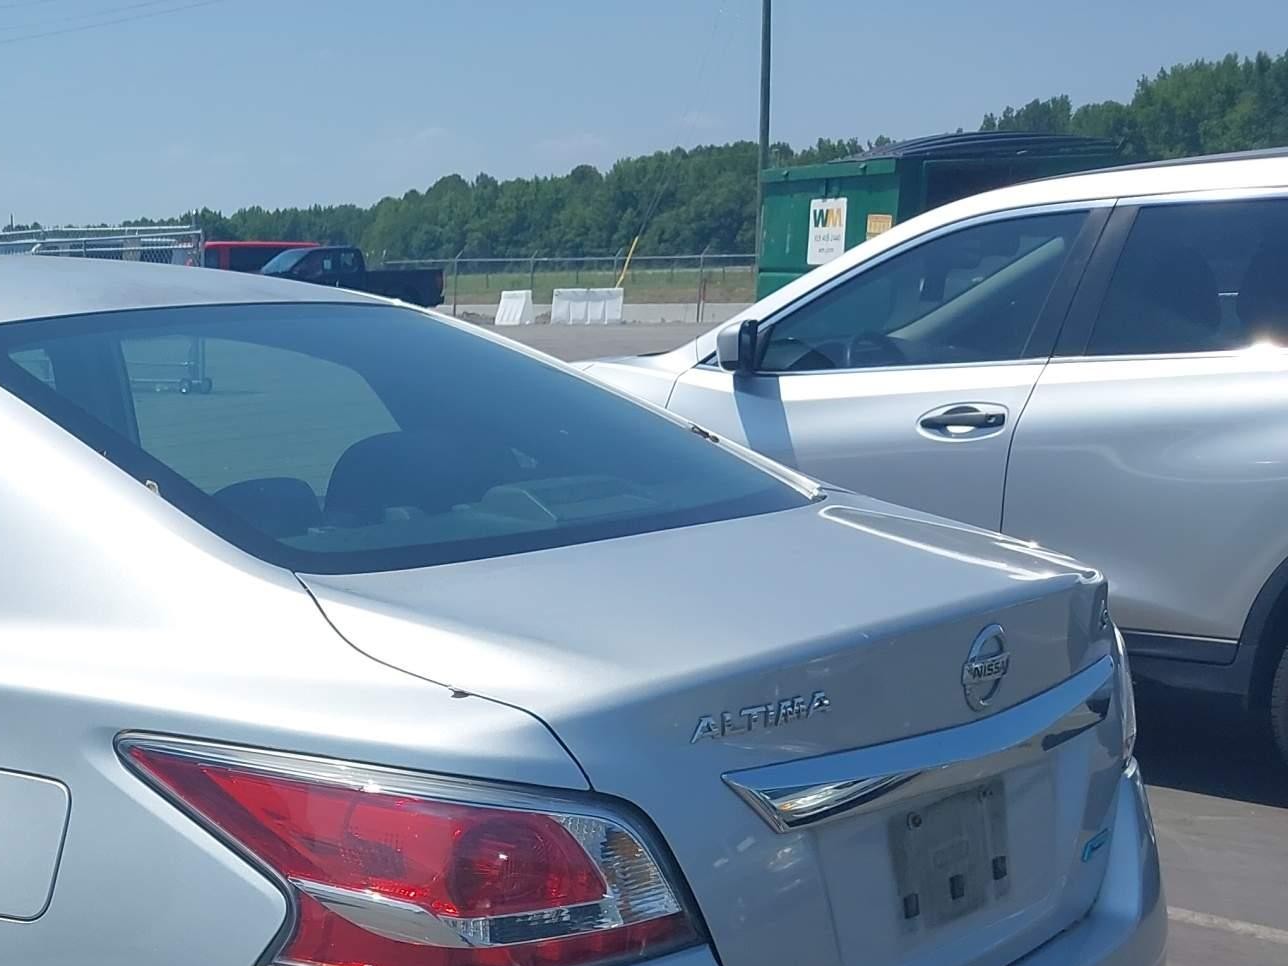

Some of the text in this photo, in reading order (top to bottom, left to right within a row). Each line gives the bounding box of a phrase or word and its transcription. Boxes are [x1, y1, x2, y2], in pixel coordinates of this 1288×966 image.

[813, 208, 842, 228] WM
[972, 656, 1008, 680] NISS
[690, 691, 831, 744] ALTIMA
